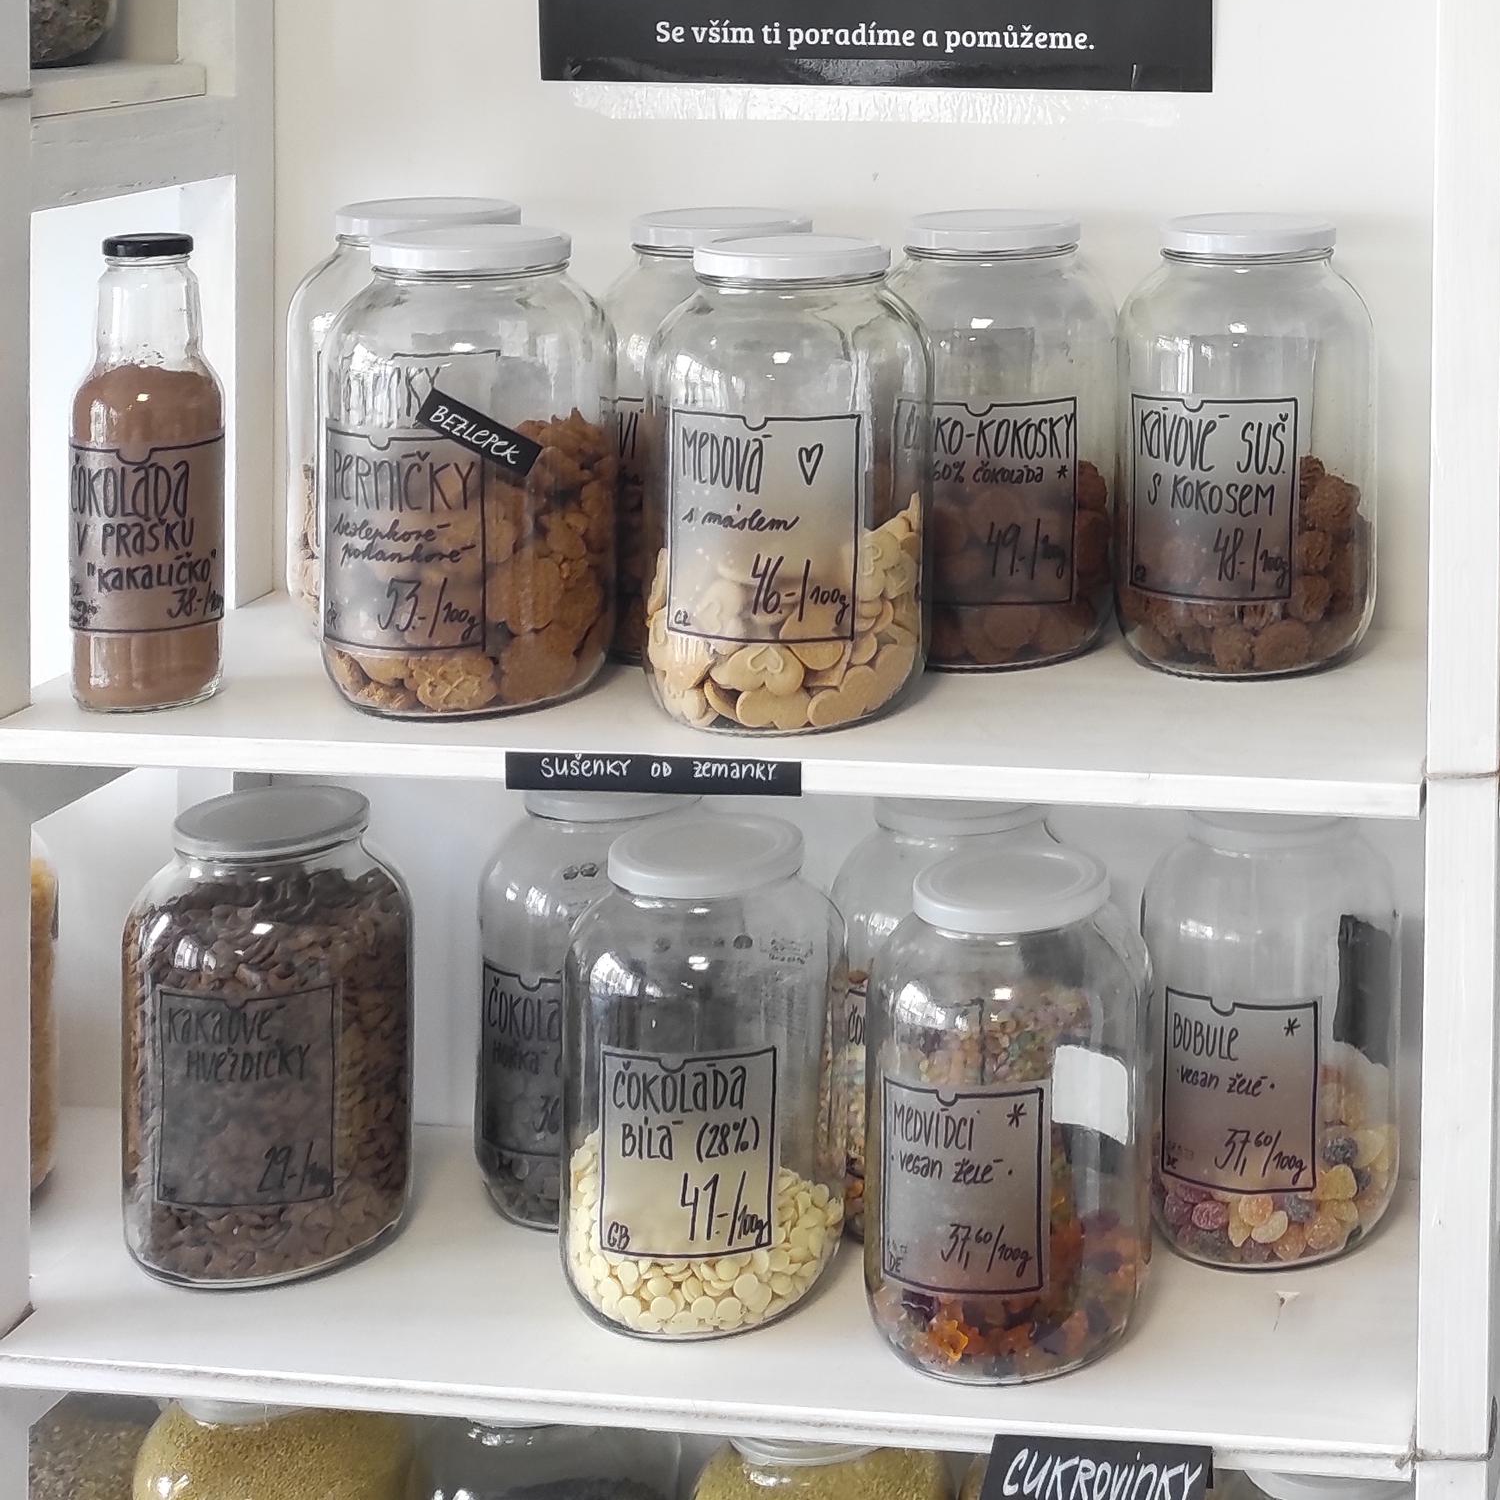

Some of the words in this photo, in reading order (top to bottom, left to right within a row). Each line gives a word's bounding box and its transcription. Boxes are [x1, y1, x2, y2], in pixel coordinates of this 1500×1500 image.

[656, 21, 685, 43] Se
[690, 19, 755, 44] vším
[761, 21, 782, 45] ti
[786, 21, 916, 51] poradíme
[922, 29, 939, 47] a
[944, 24, 1095, 54] pomůžeme.
[429, 404, 521, 465] BEZLEPEK
[1139, 406, 1230, 473] KÁVOVÉ
[332, 450, 475, 512] PERNÍČKY
[681, 427, 772, 494] MEDOVÁ
[70, 453, 190, 522] ČOKOLÁDA
[1170, 474, 1276, 517] KOKOSEM
[76, 523, 90, 556] V
[101, 516, 194, 557] PRÁŠKU
[701, 504, 800, 532] máslem
[540, 753, 632, 779] SUŠENKY
[650, 763, 673, 778] OD
[693, 760, 777, 781] ZEMANKY
[167, 1003, 286, 1046] KAKAOVÉ
[488, 970, 562, 1043] ČOKOLÁ
[1173, 1011, 1240, 1061] BOBULE
[612, 1061, 747, 1114] ČOKOLÁDA
[696, 1116, 760, 1163] (28%)
[893, 1102, 981, 1151] MEDVÍDCI
[1002, 1447, 1203, 1500] CUKROVINKY
